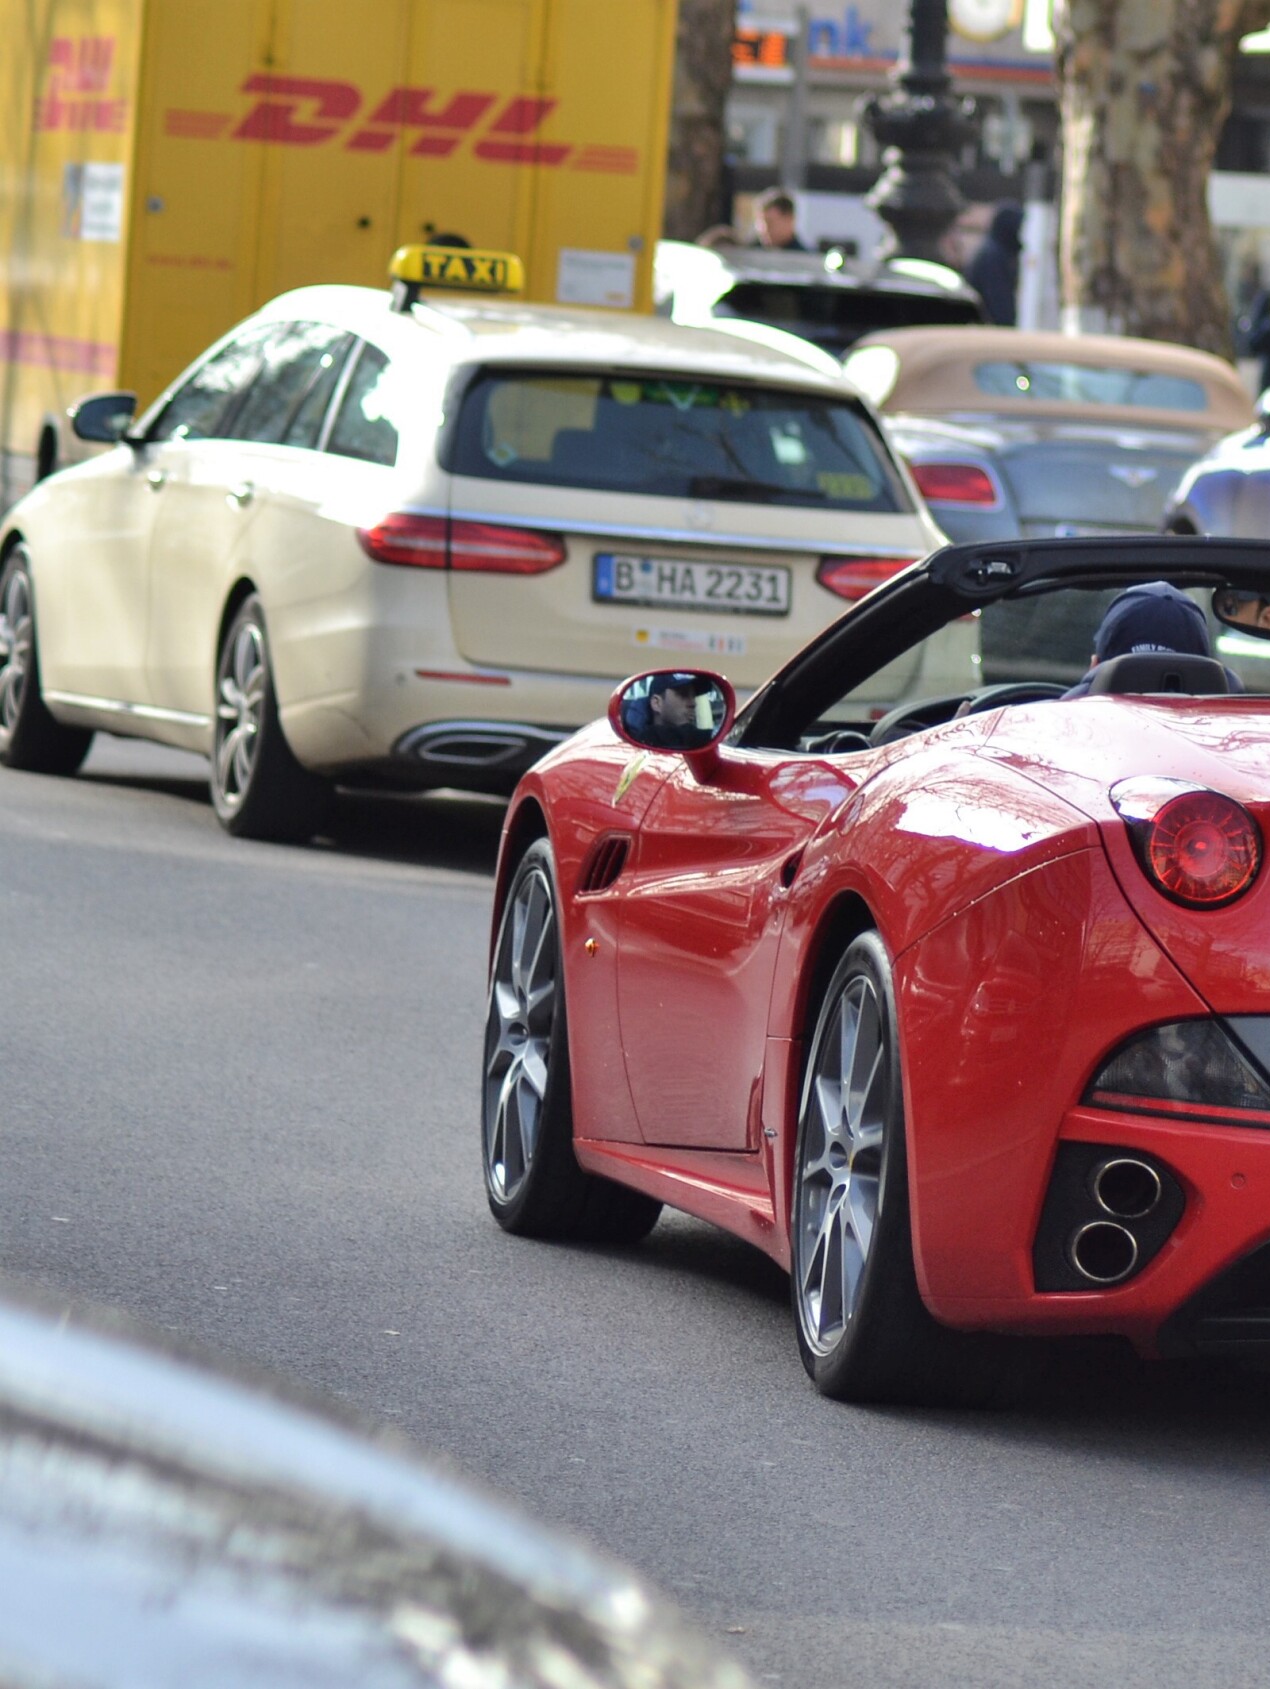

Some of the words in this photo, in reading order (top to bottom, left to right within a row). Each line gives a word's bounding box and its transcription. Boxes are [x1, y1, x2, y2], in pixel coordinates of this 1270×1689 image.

[231, 72, 573, 166] DHL
[424, 253, 505, 283] TAXI
[616, 562, 634, 592] B
[657, 565, 696, 597] HA
[705, 568, 781, 604] 2231
